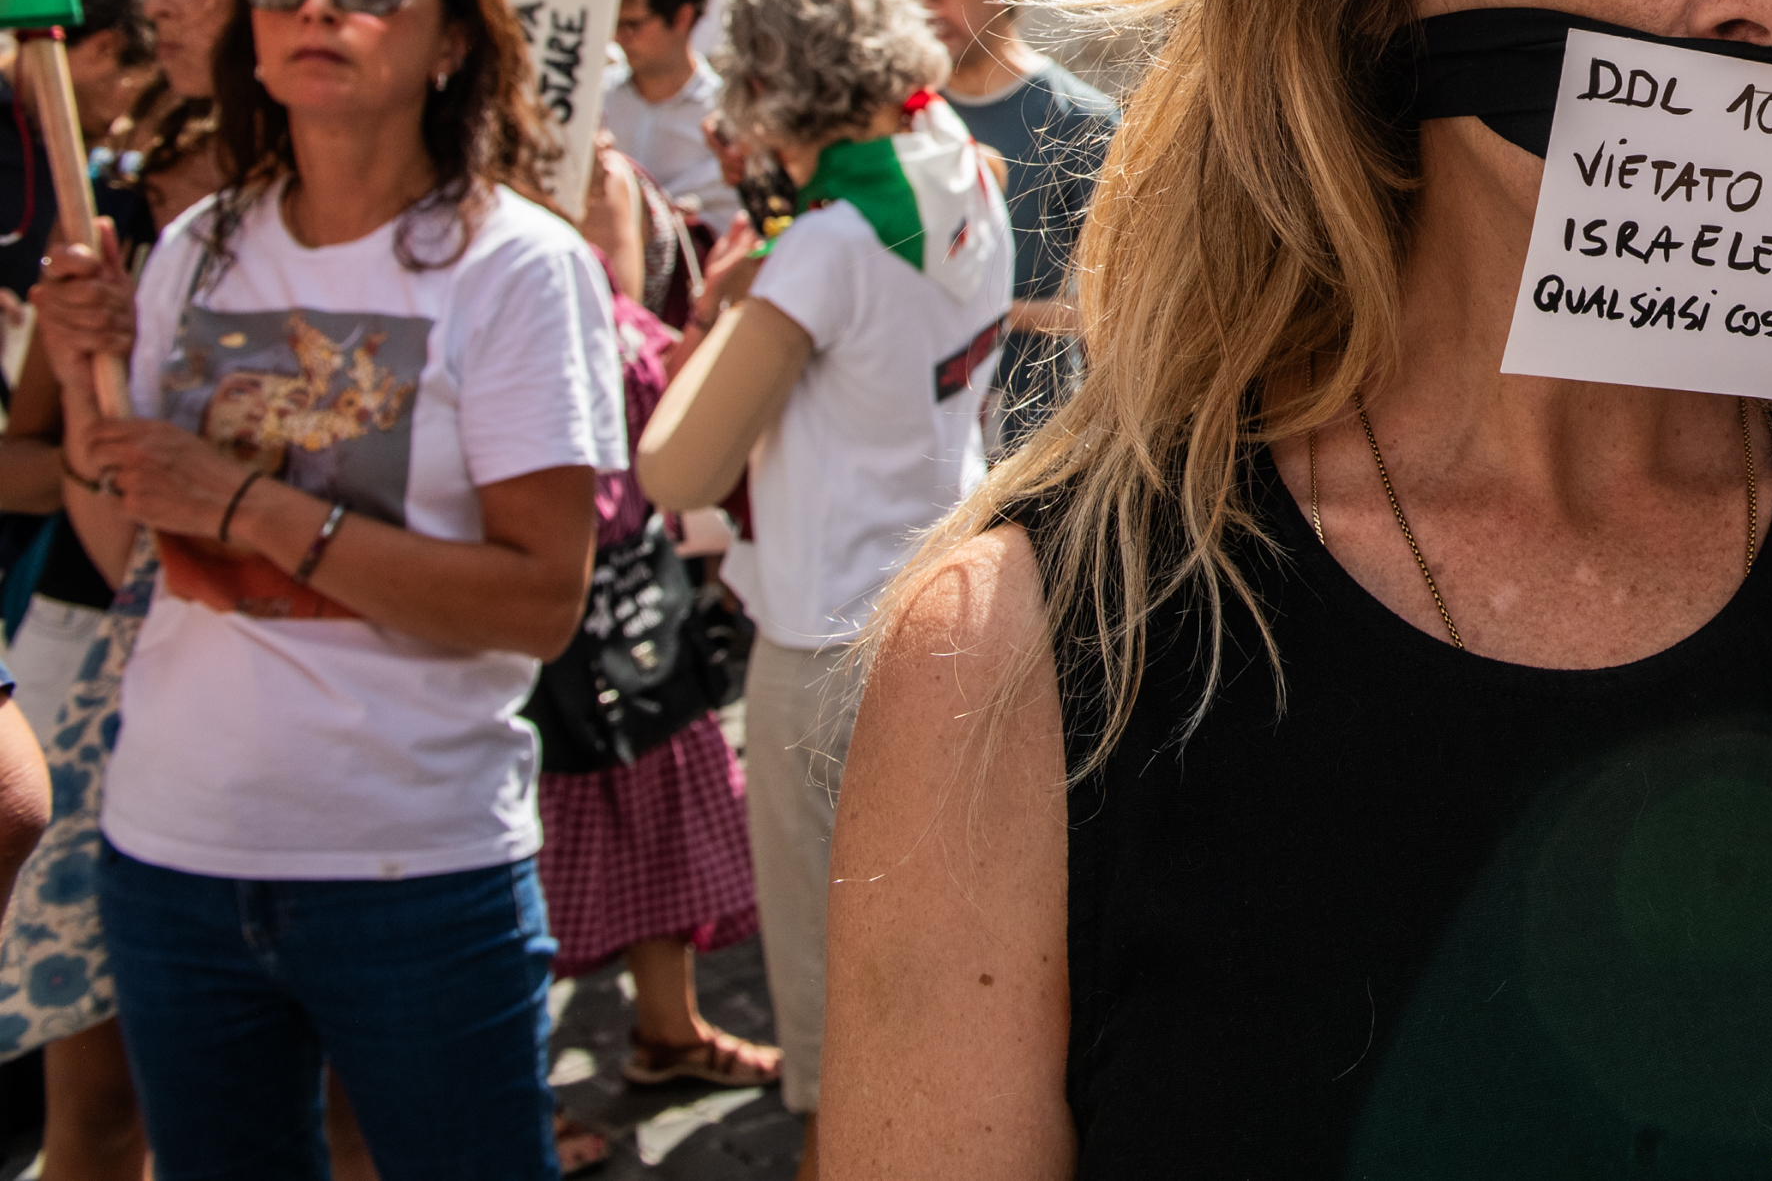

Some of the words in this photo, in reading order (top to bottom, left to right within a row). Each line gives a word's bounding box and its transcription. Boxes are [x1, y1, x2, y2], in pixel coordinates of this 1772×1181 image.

[538, 5, 588, 125] STARE
[1575, 57, 1694, 116] DDL
[1573, 137, 1764, 213] VIETATO
[1533, 274, 1718, 332] QUALSIASI
